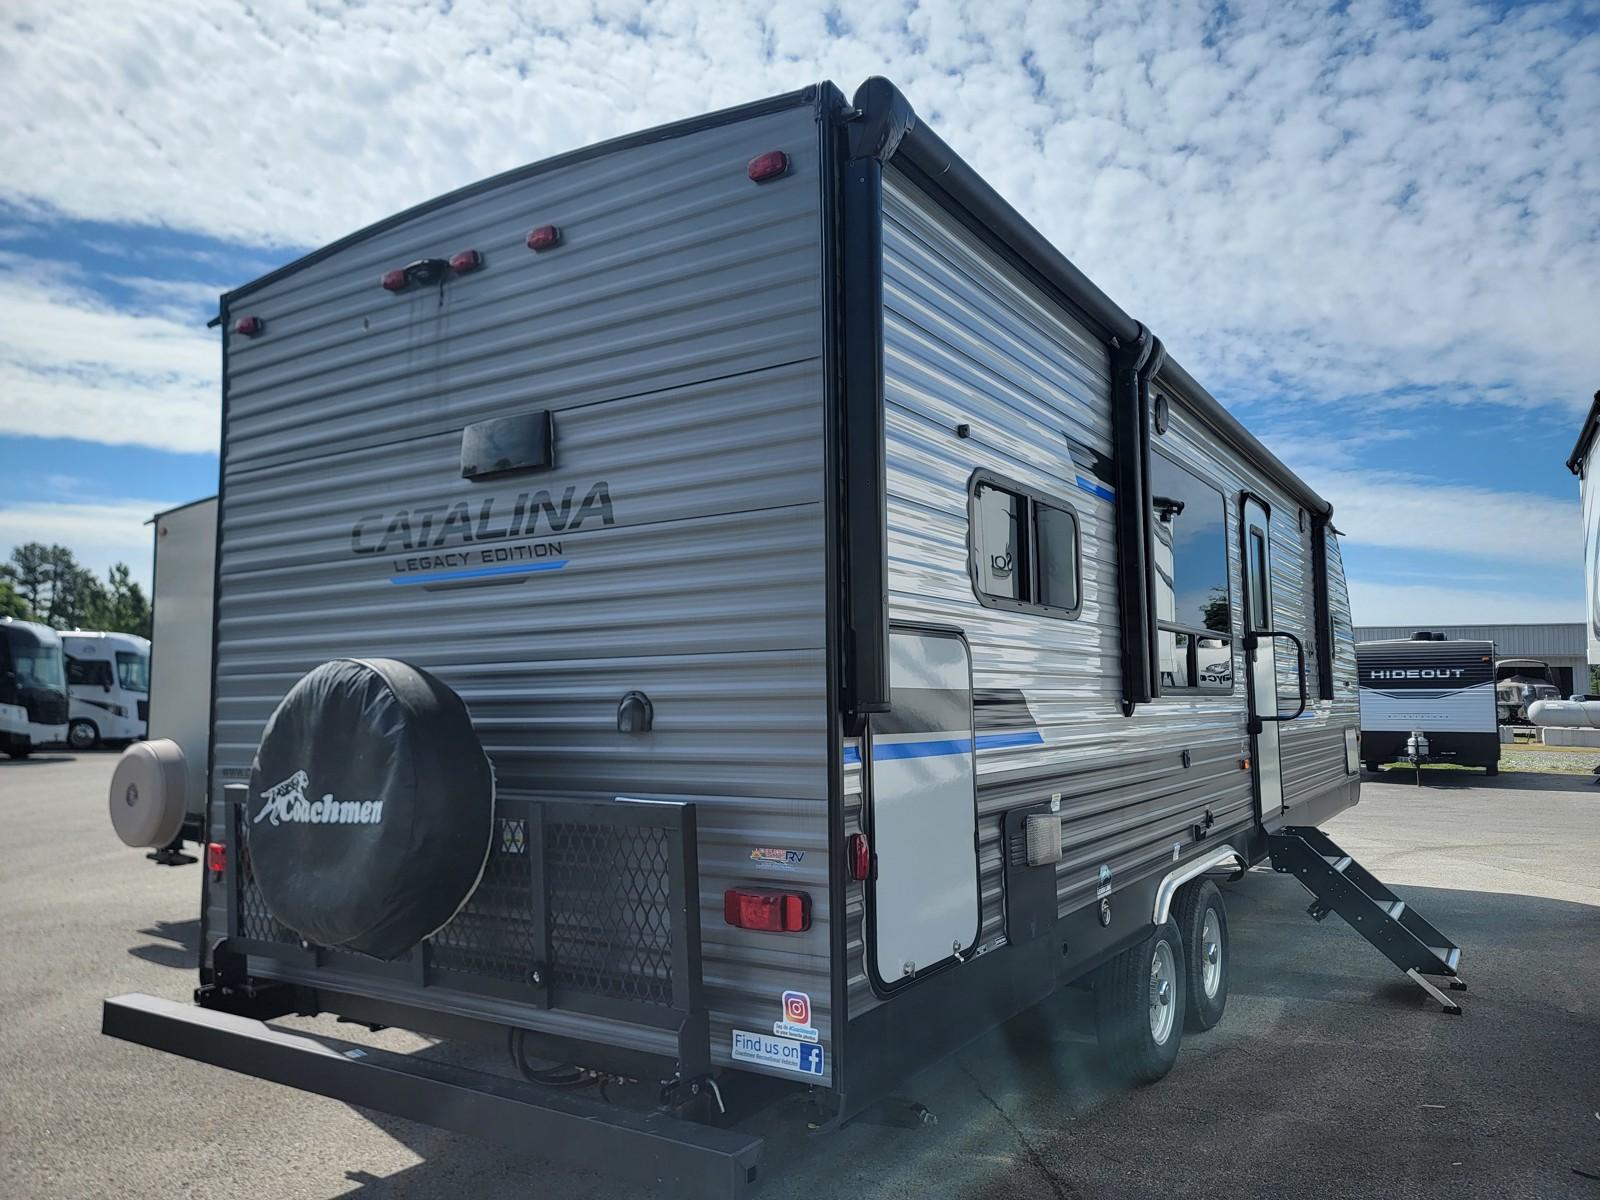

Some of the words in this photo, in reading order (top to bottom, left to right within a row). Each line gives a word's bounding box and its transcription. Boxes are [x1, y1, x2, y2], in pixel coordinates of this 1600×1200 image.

[350, 480, 616, 554] CATALINA
[393, 551, 470, 573] LEGACY
[481, 541, 564, 564] EDITION
[1370, 668, 1465, 679] HIDEOUT
[279, 793, 384, 824] Coachmen
[735, 1033, 761, 1052] Find
[764, 1041, 779, 1056] us
[782, 1046, 799, 1059] on
